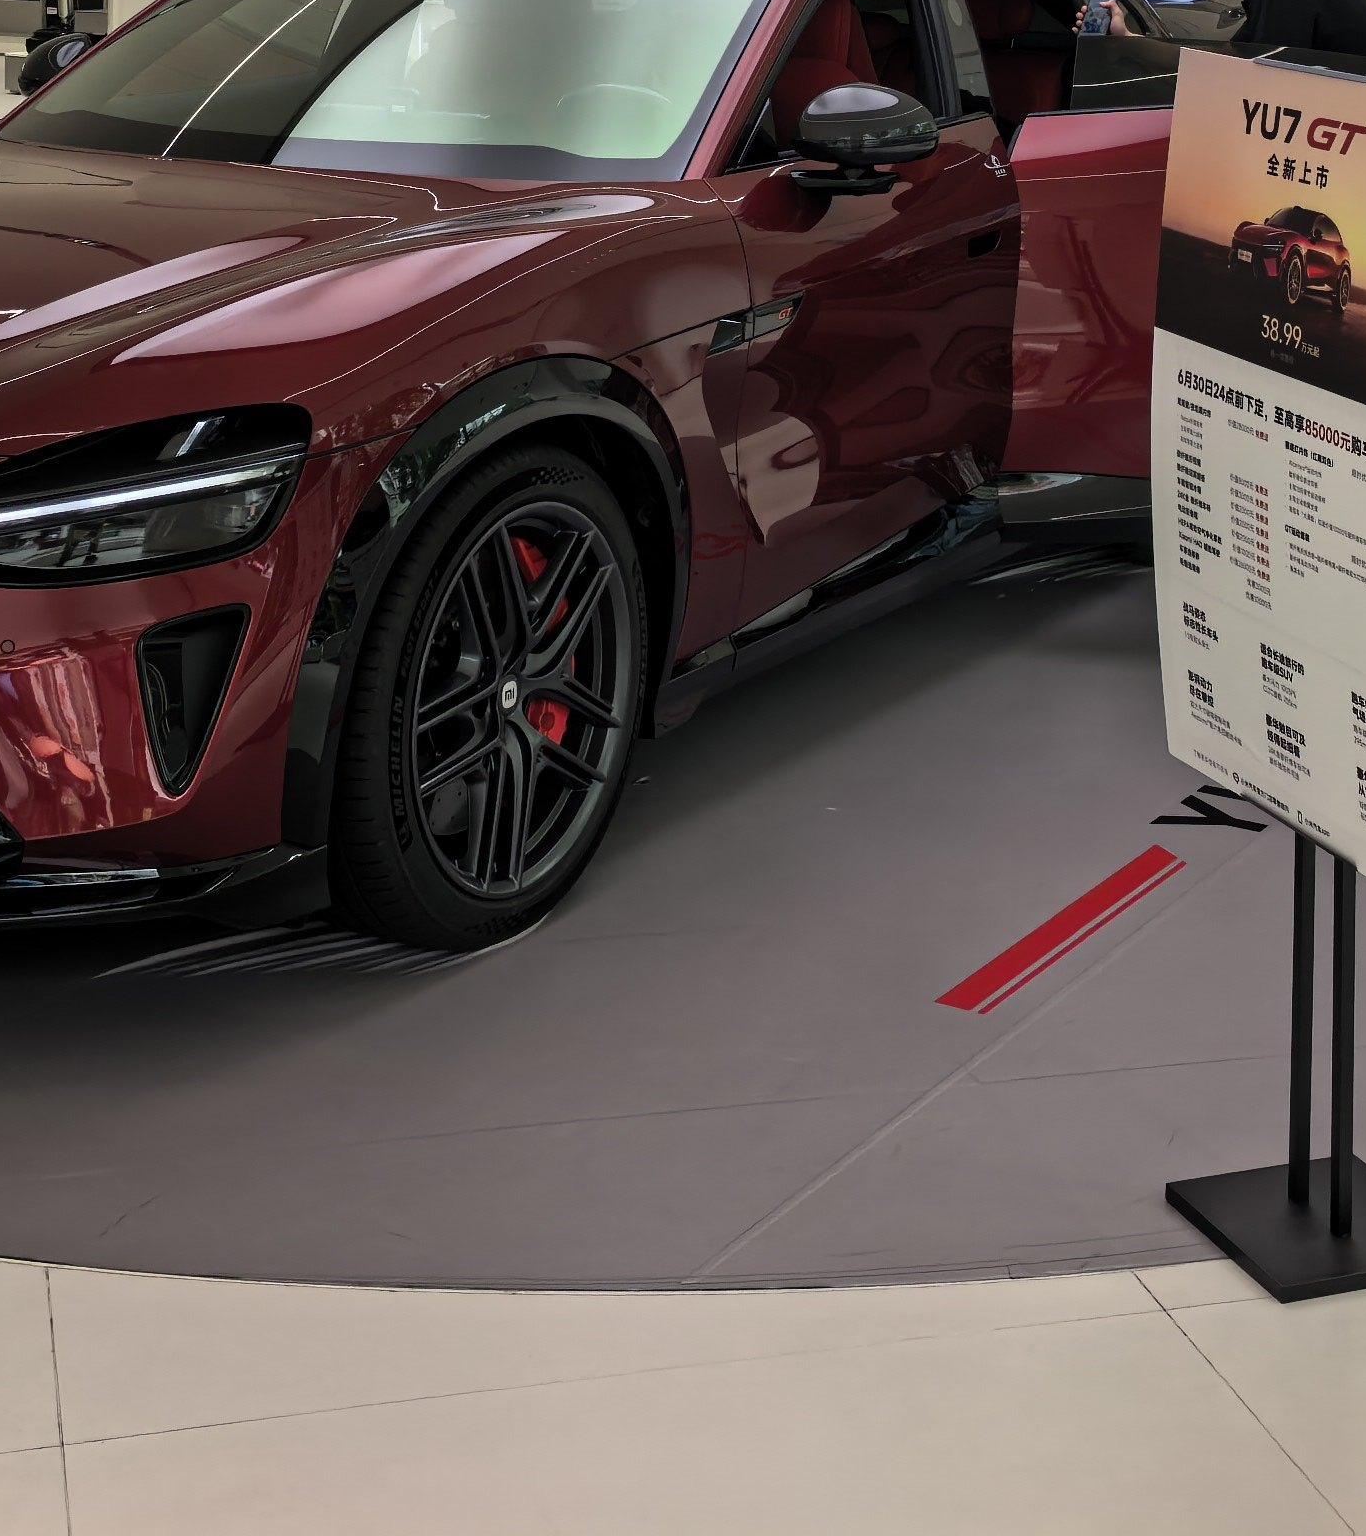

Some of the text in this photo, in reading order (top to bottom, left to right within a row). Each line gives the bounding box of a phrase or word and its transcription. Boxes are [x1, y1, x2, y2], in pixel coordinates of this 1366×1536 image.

[1242, 98, 1303, 144] YU7
[1266, 153, 1330, 190] 全新上市
